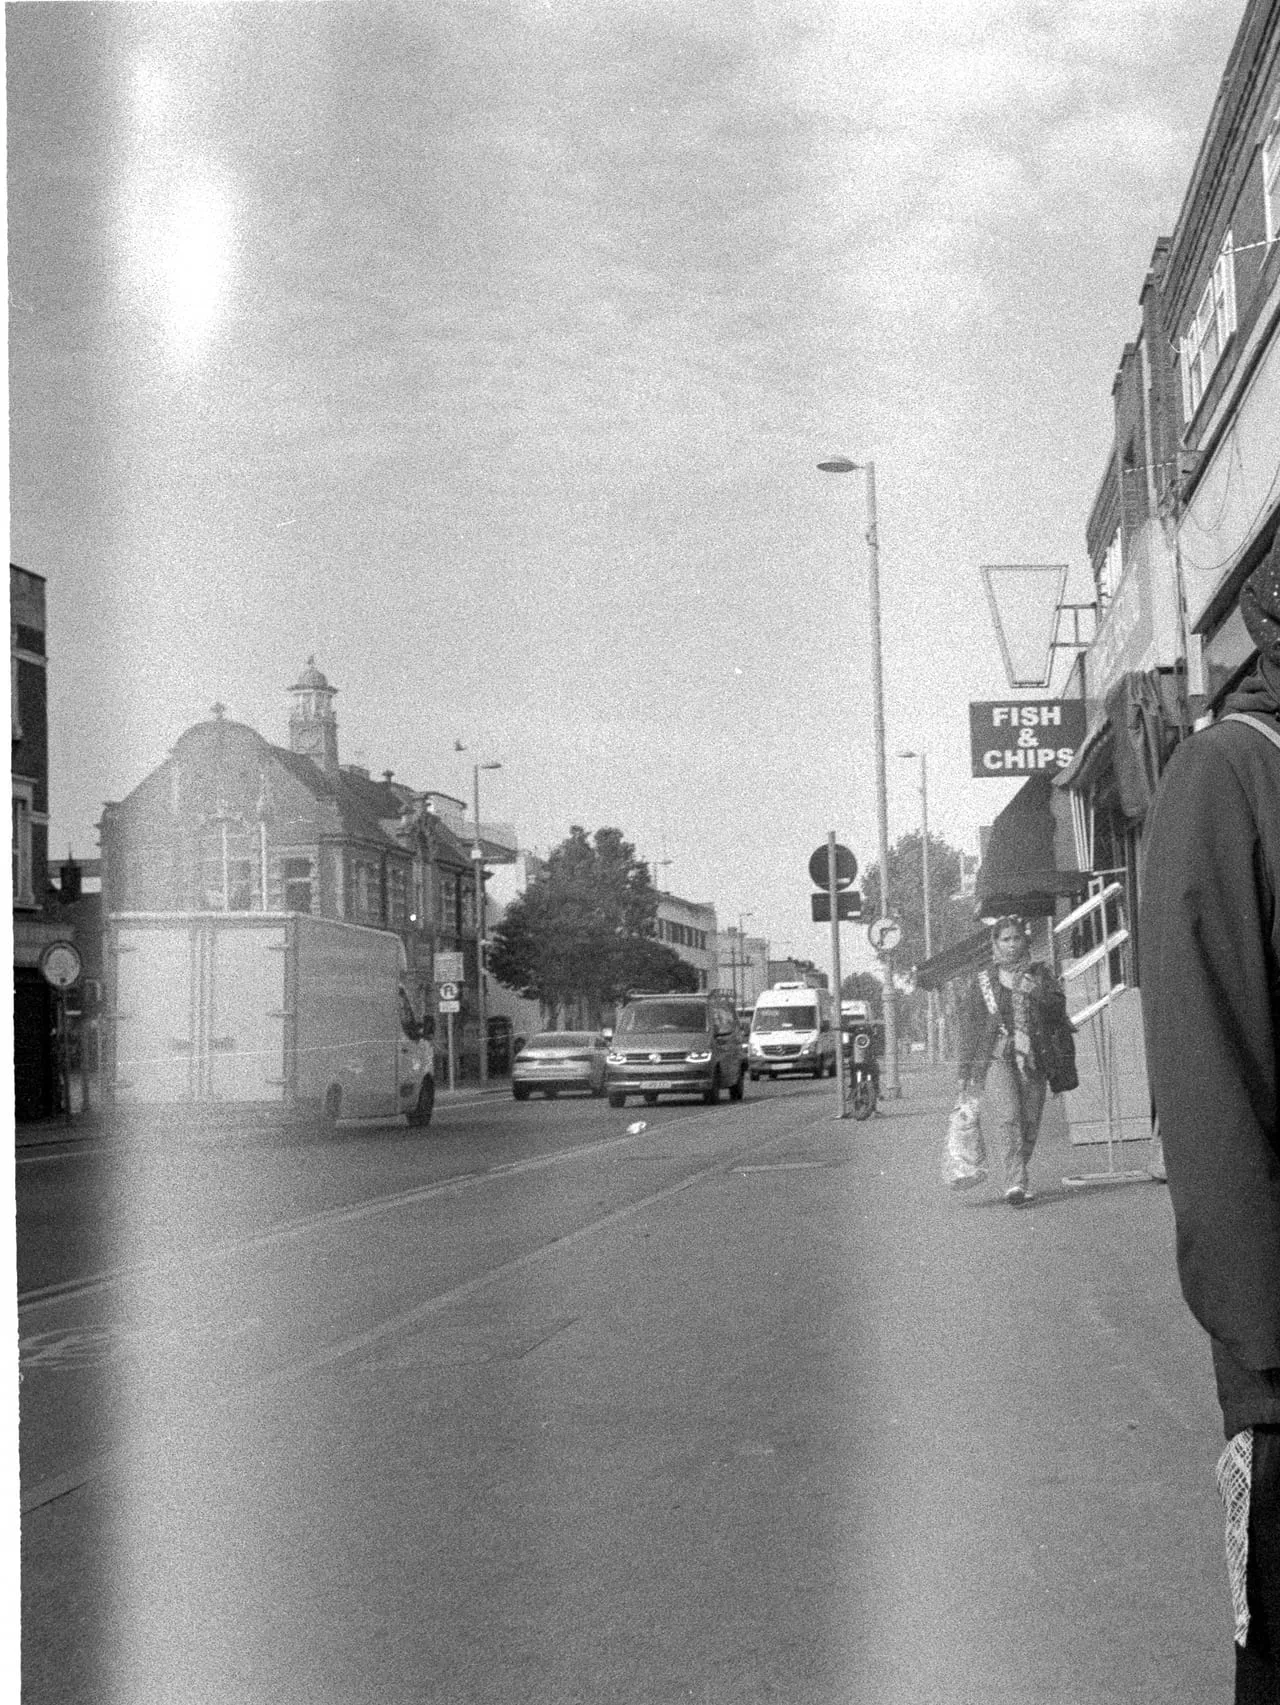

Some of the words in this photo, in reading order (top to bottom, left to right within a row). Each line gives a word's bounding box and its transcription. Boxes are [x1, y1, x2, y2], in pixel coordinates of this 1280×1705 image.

[992, 706, 1061, 726] FISH
[1017, 727, 1039, 748] &
[982, 748, 1074, 769] CHIPS
